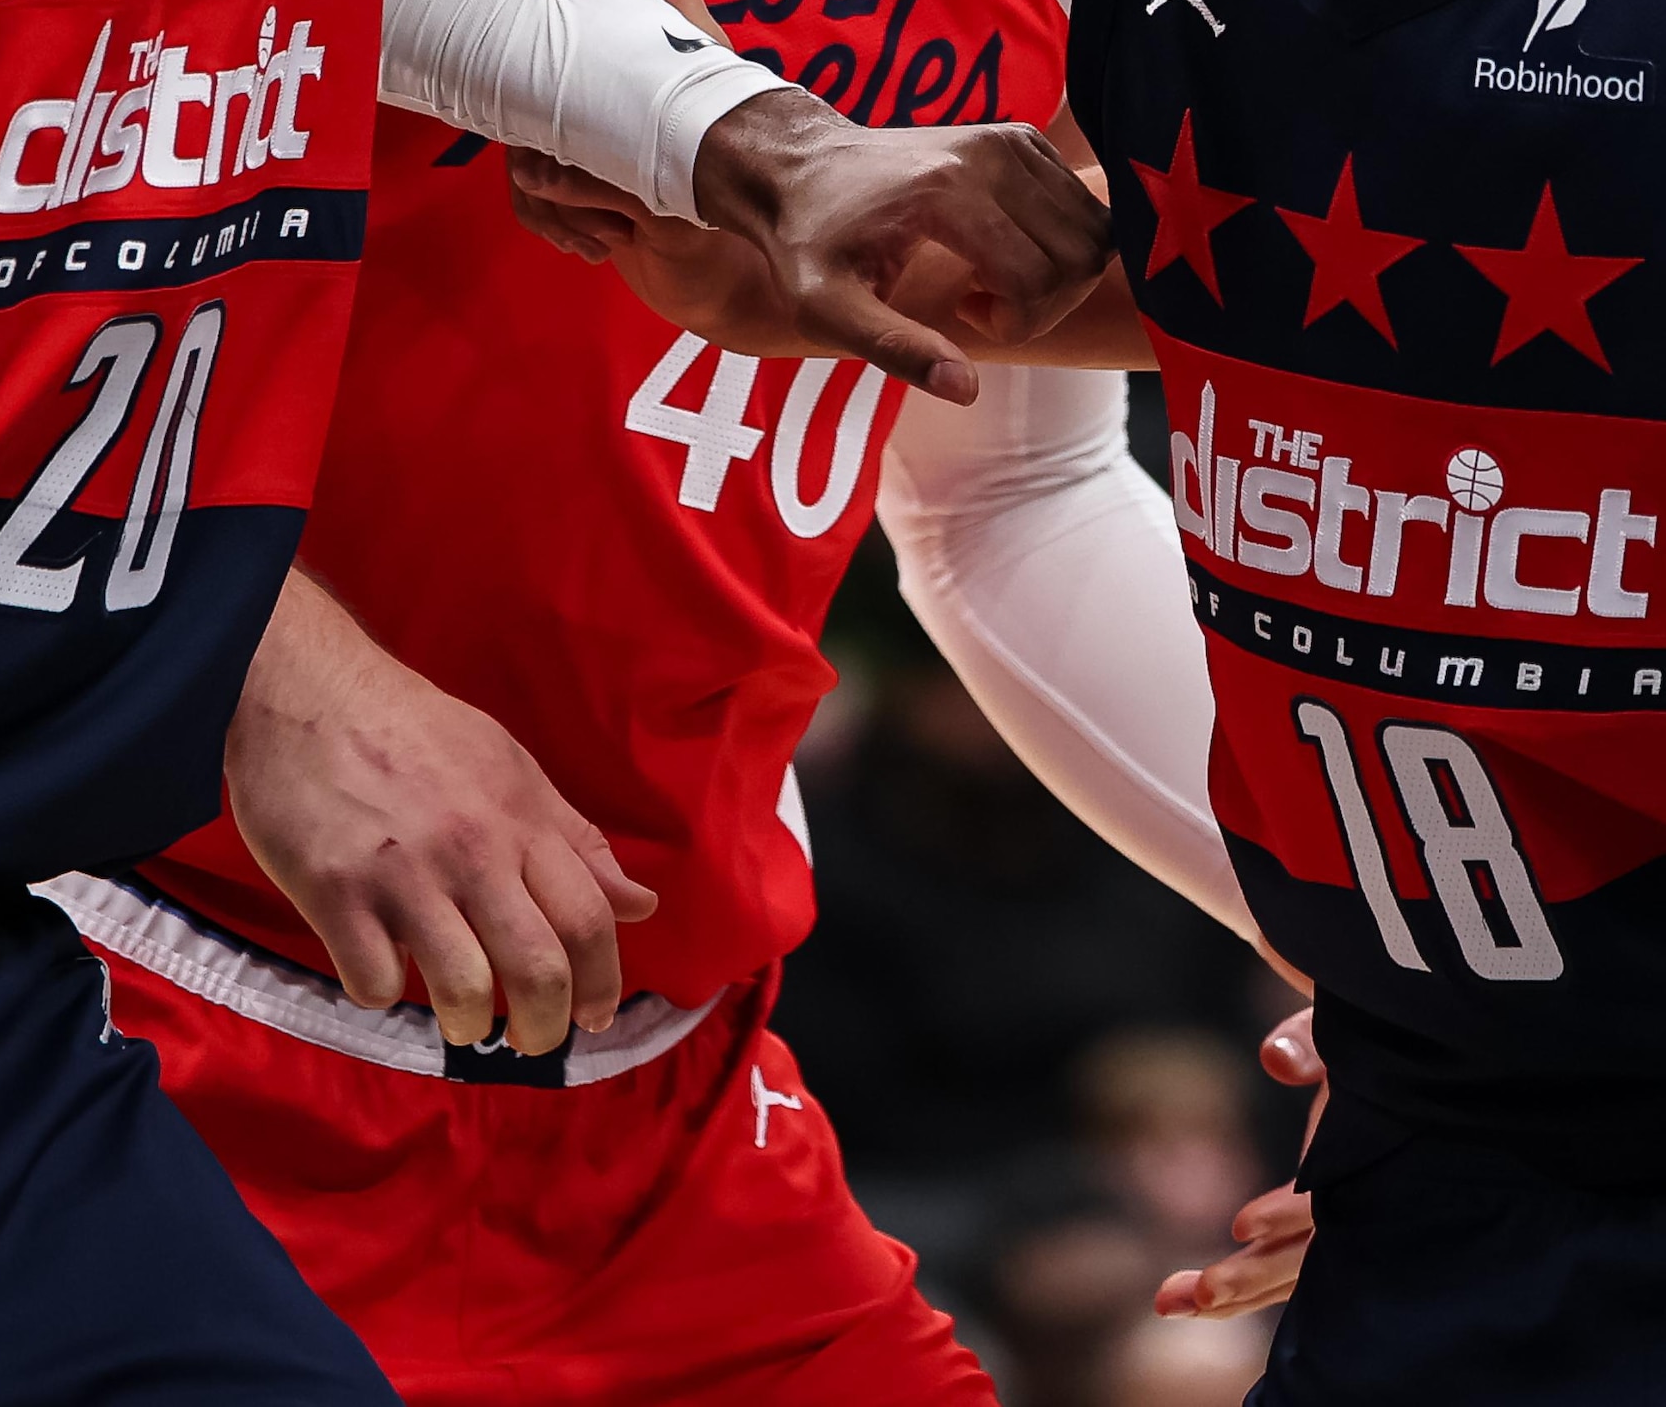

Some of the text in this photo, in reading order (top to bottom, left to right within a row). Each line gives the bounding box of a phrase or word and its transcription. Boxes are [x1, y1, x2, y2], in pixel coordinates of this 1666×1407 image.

[129, 30, 165, 82] TH
[1473, 57, 1645, 103] Robinhood
[624, 329, 888, 539] 40
[1248, 419, 1323, 470] THE
[1254, 611, 1662, 695] COLUMBIA
[1295, 699, 1565, 981] 18
